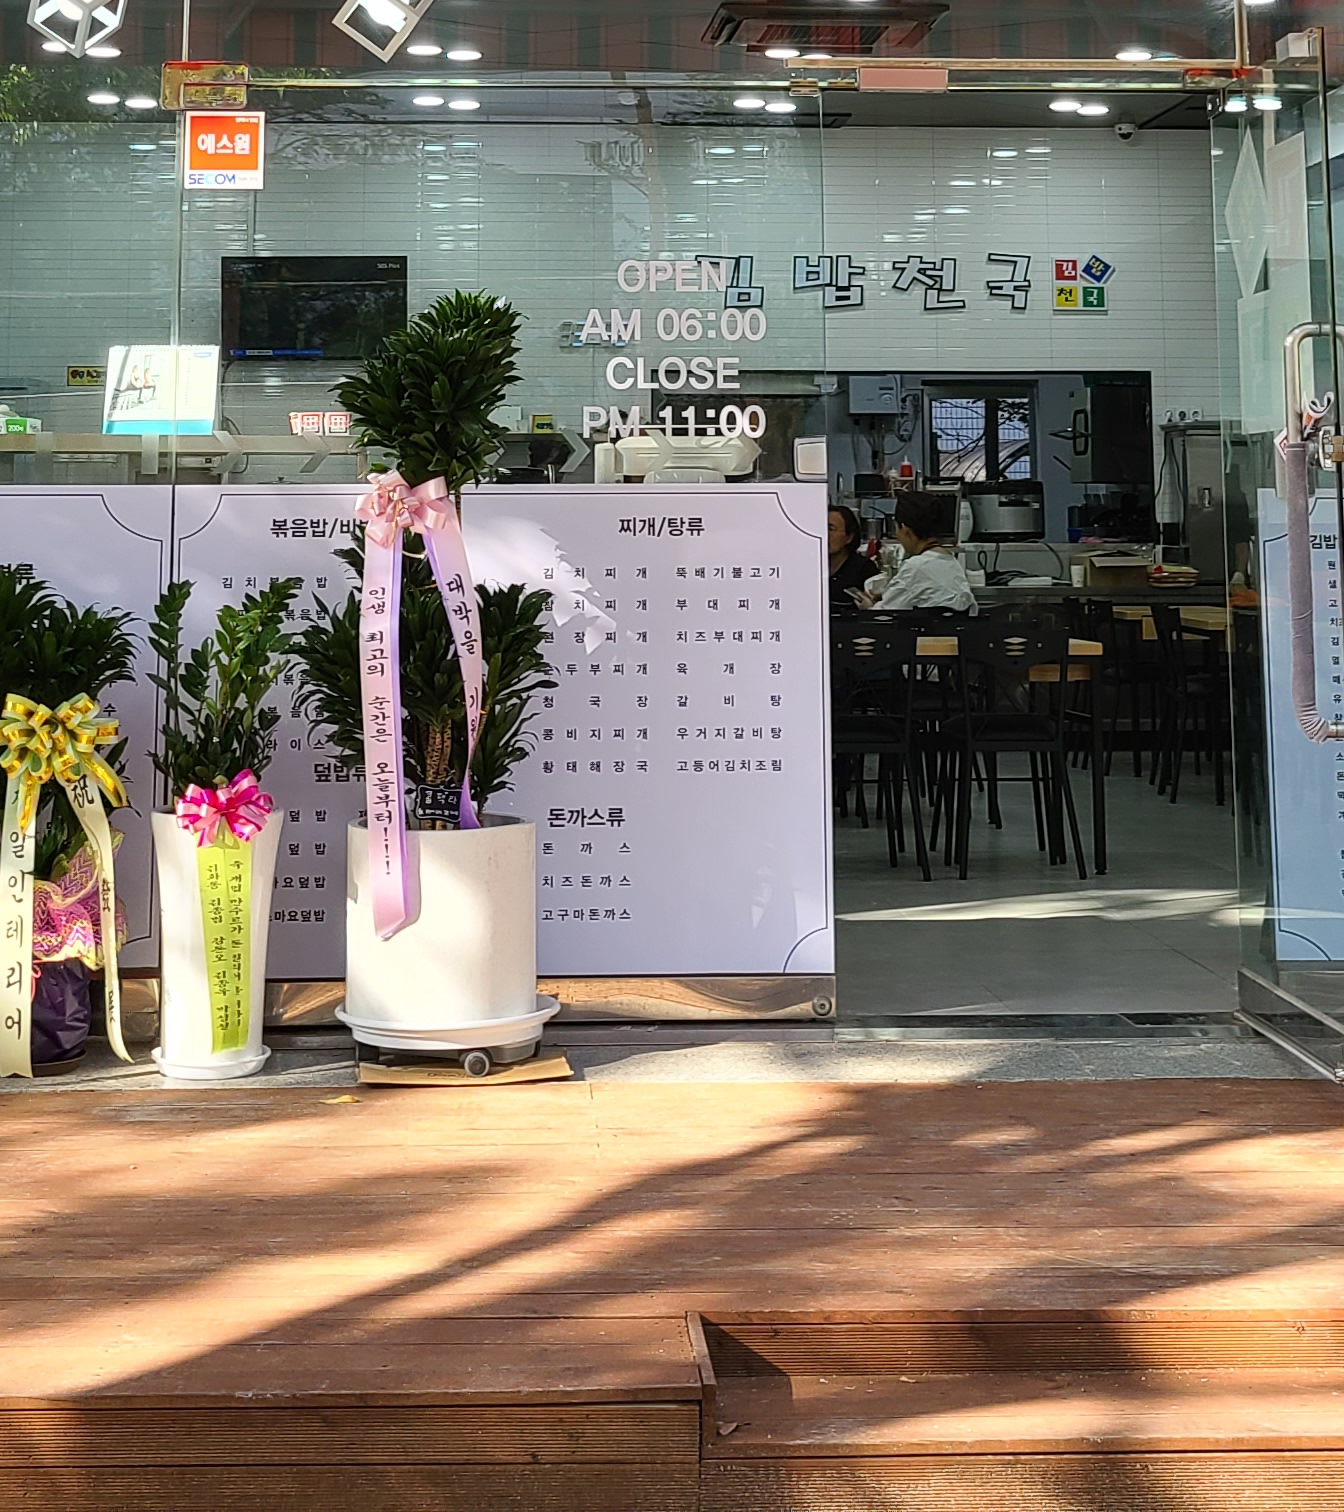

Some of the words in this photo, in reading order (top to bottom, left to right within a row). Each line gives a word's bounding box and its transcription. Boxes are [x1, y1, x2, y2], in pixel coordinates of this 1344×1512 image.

[197, 133, 251, 155] 에스원
[188, 173, 236, 185] SECOM
[617, 260, 726, 292] OPEN
[695, 254, 1031, 310] 김밥천국
[580, 308, 642, 341] AM
[656, 308, 767, 341] 06:00
[606, 356, 741, 389] CLOSE
[582, 405, 639, 439] PM
[658, 405, 766, 439] 11:00
[618, 516, 705, 538] 찌개/탕류
[544, 567, 647, 580] 김치찌개
[675, 566, 780, 579] 뚝배기불고기
[367, 586, 387, 614] 인생
[675, 598, 780, 611] 부대찌개
[445, 573, 478, 655] 대박을
[676, 630, 781, 643] 치즈부대찌개
[365, 630, 389, 677] 최고의
[676, 662, 782, 675] 육개장
[542, 695, 648, 709] 청국장
[676, 694, 782, 708] 갈비탕
[367, 694, 391, 743] 순간은
[542, 728, 648, 741] 콩비지찌개
[676, 727, 782, 740] 우거지갈비탕
[542, 760, 648, 774] 황태해장국
[676, 759, 782, 773] 고등어김치조림
[547, 807, 626, 828] 돈까스류
[541, 842, 631, 855] 돈까스
[542, 875, 631, 888] 치즈돈까스
[4, 788, 27, 1040] 일인테리어
[541, 908, 631, 921] 고구마돈까스
